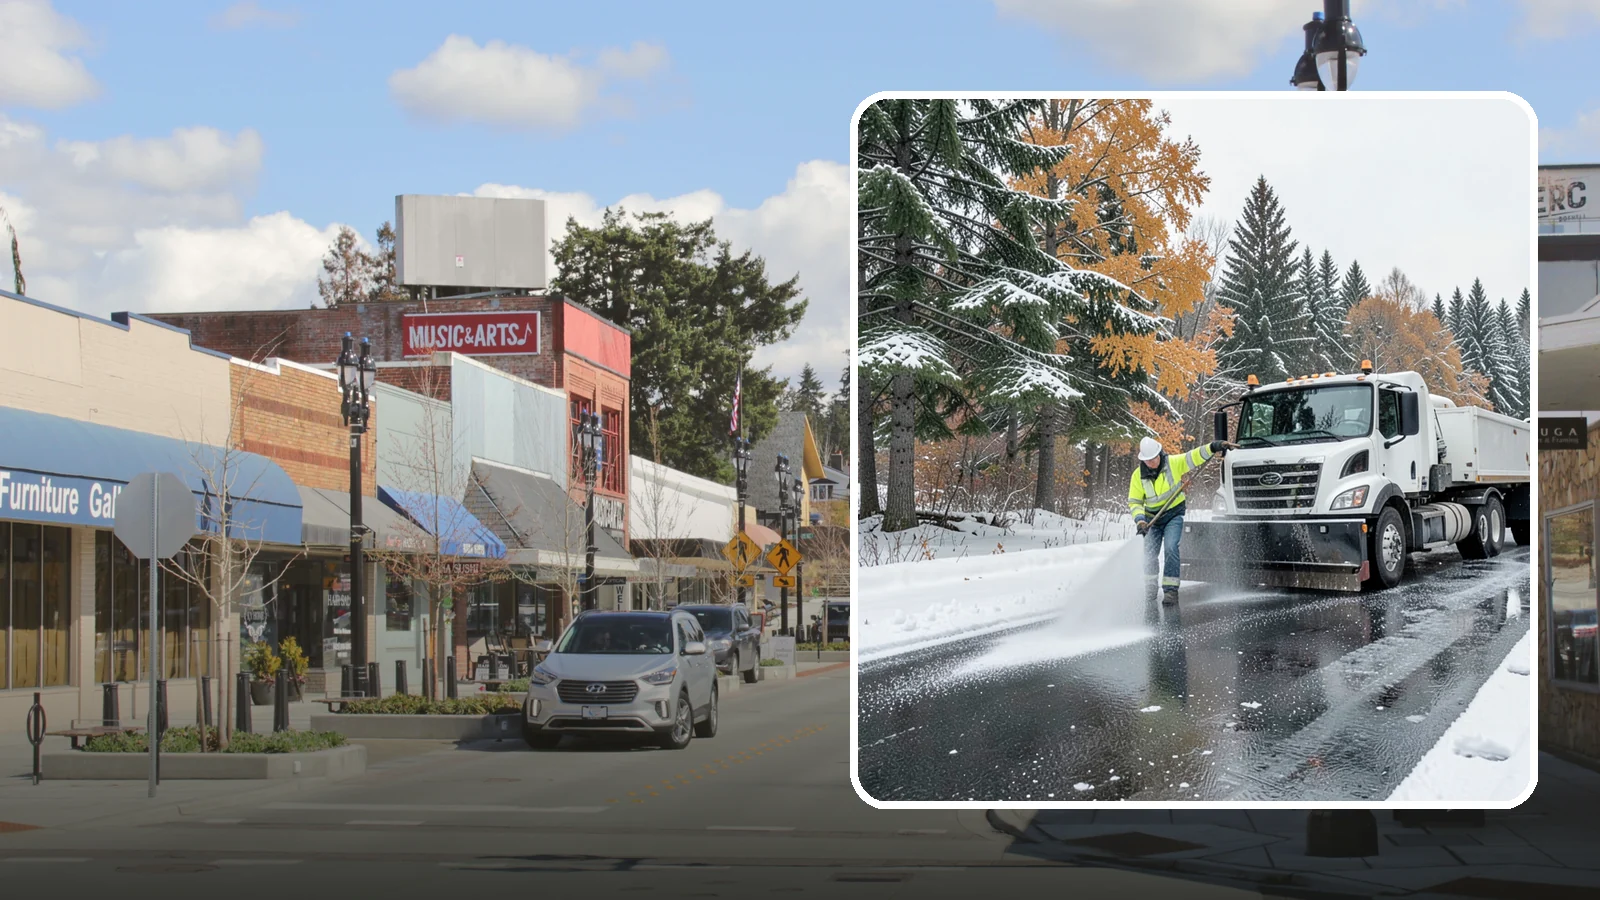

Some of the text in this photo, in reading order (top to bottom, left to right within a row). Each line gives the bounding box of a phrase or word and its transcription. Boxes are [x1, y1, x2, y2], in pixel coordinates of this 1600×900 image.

[1540, 427, 1578, 436] UGA
[0, 471, 79, 515] Furniture
[453, 563, 479, 574] SUSHI
